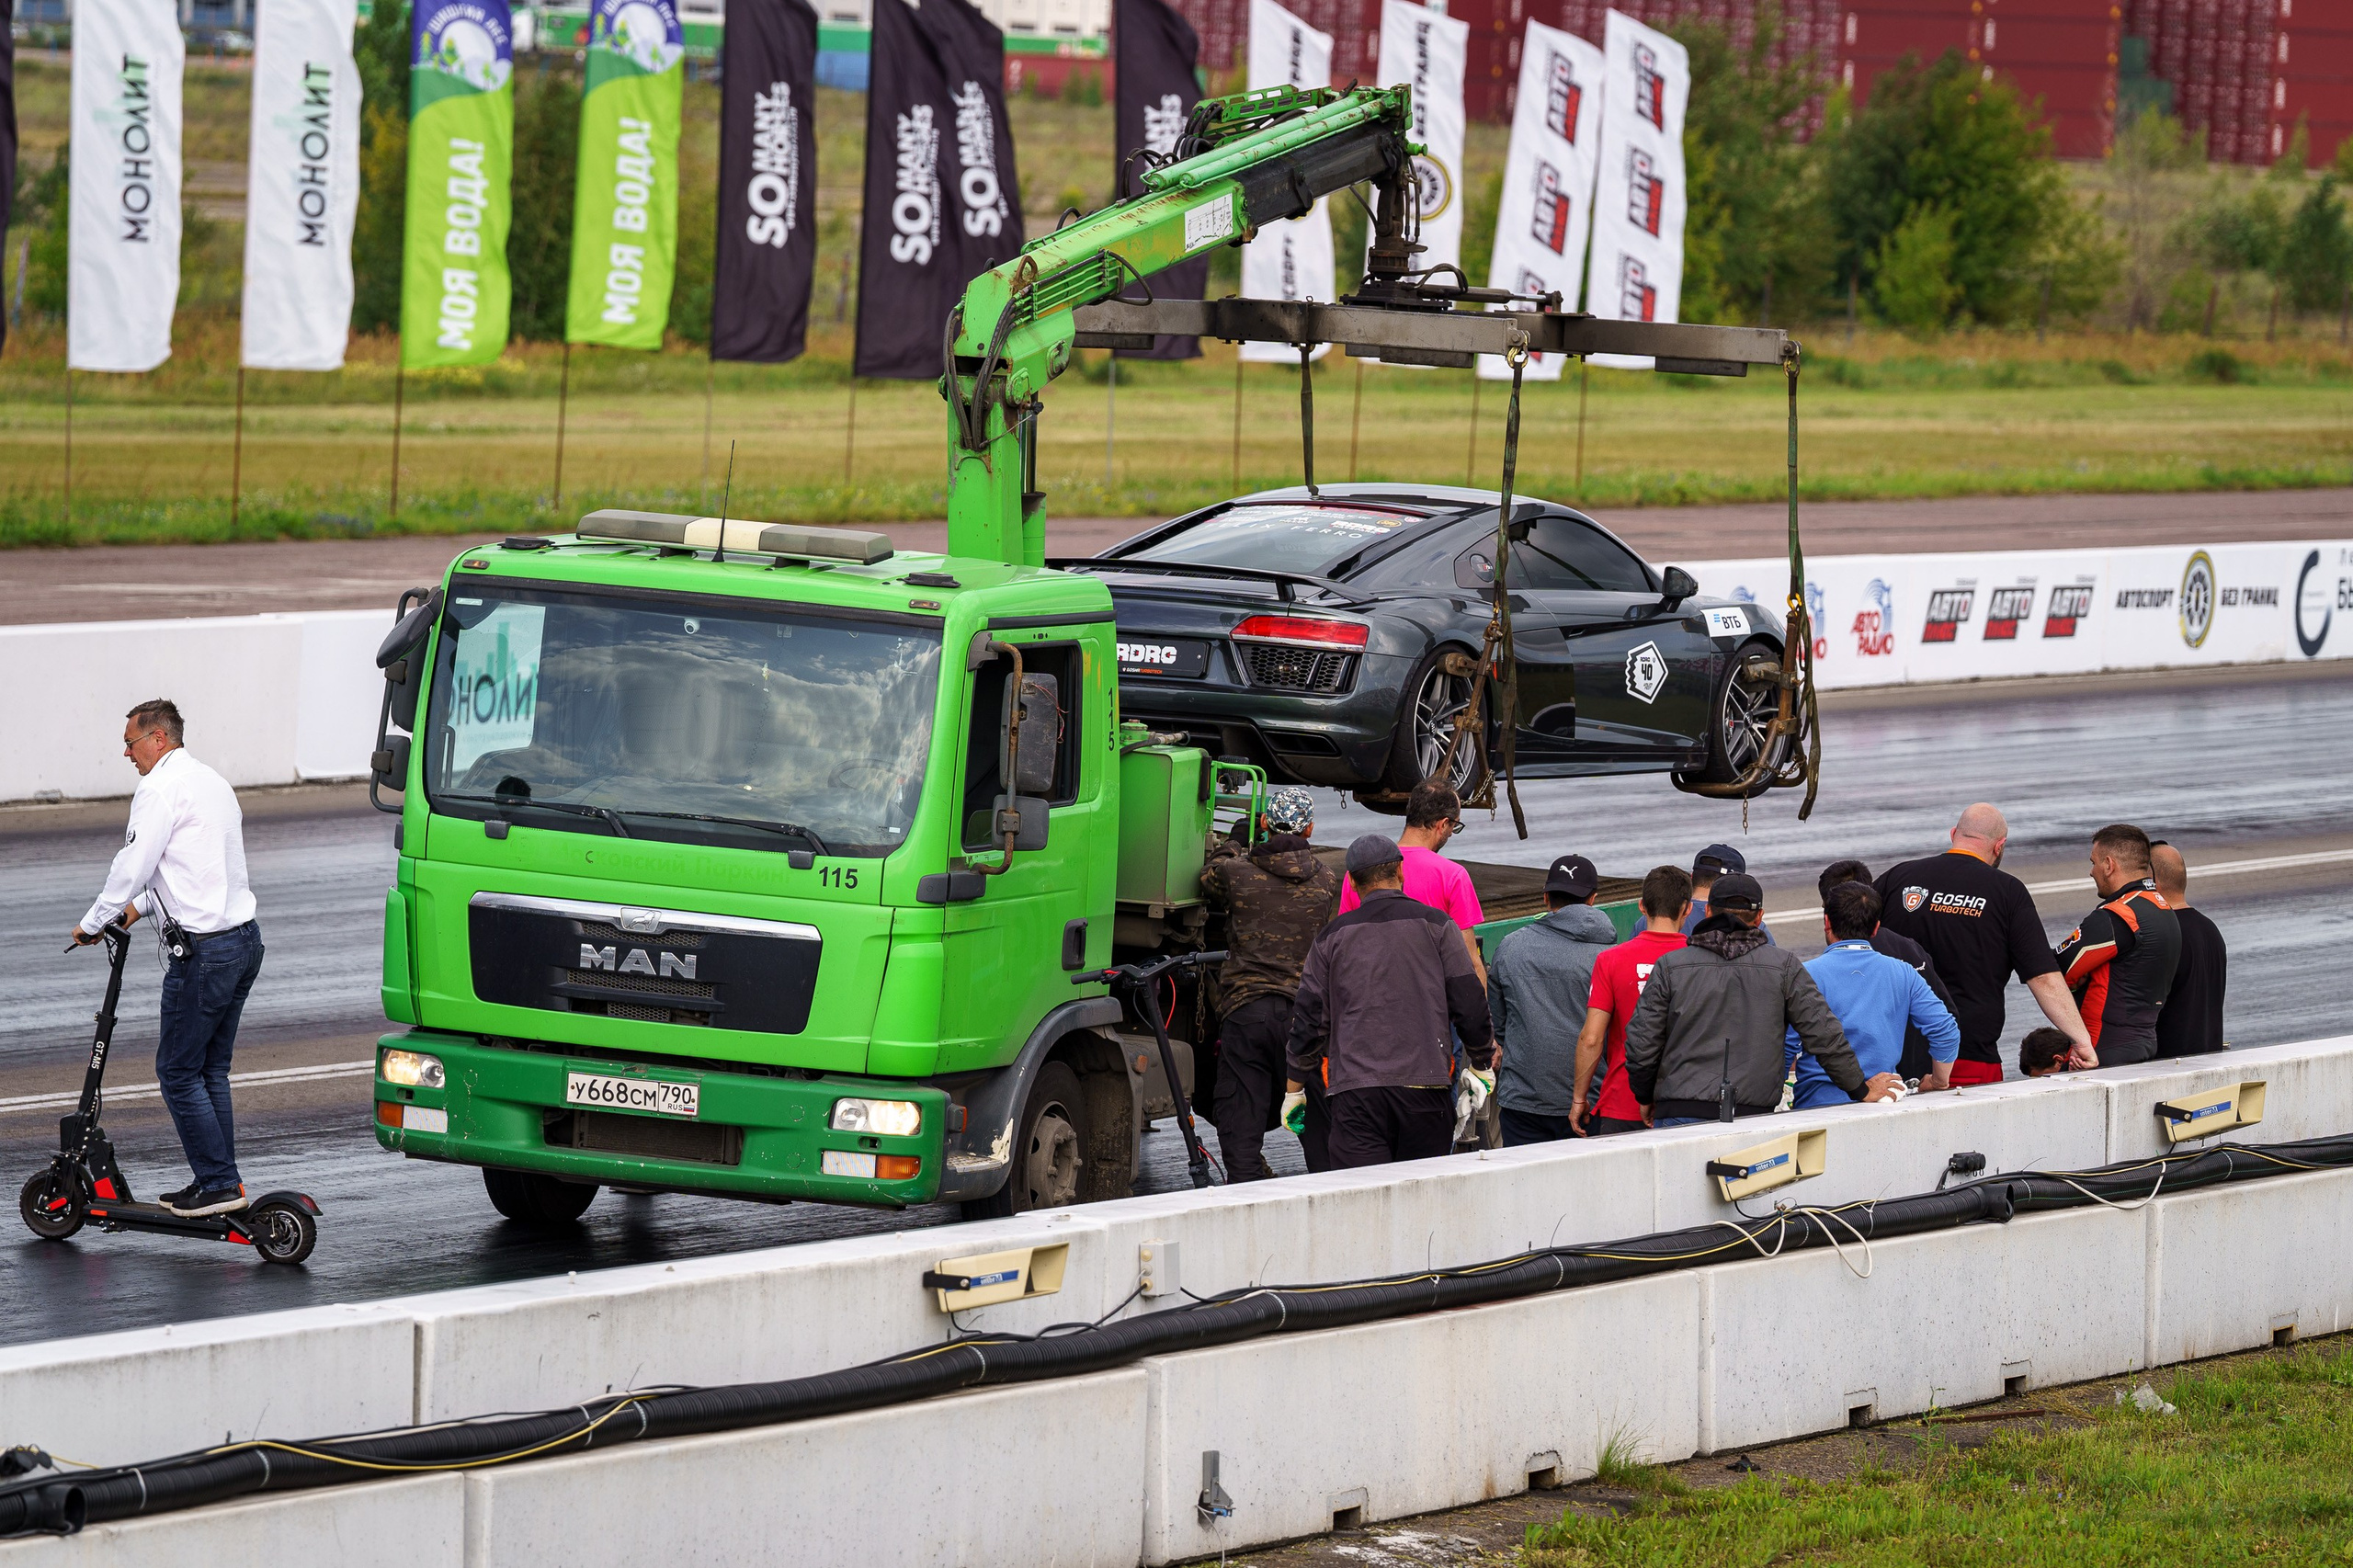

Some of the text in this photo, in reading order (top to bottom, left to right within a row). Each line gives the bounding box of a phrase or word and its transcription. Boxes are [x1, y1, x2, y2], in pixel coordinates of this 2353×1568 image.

[752, 92, 773, 172] MANY
[122, 53, 152, 243] МОНОЛИТ
[299, 62, 332, 246] МОНОЛИТ
[896, 112, 915, 191] MANY
[961, 165, 1002, 238] SO
[1533, 162, 1561, 247] АВТО
[1629, 147, 1654, 233] АВТО
[601, 117, 656, 324] МОЯ ВОДА!
[746, 172, 790, 249] SO
[890, 190, 933, 266] SO
[437, 138, 490, 352] МОЯ ВОДА!
[1290, 525, 1363, 539] FERRO
[1928, 592, 1973, 621] АВТО
[1989, 590, 2033, 619] АВТО
[2049, 588, 2092, 618] АВТО
[2116, 589, 2174, 608] АВТОСПОРТ
[2221, 587, 2279, 608] БЕЗ ГРАНИЦ
[1722, 616, 1742, 629] ВТБ
[1851, 611, 1881, 633] АВТО
[1857, 632, 1894, 656] РАДИО
[1641, 663, 1654, 681] 40
[818, 866, 858, 889] 115
[1929, 903, 1983, 917] TURBOTECH
[1931, 892, 1987, 911] GOSHA
[580, 943, 698, 980] MAN
[91, 1040, 105, 1070] GT-M5
[661, 1085, 693, 1105] 790
[667, 1103, 683, 1111] RUS
